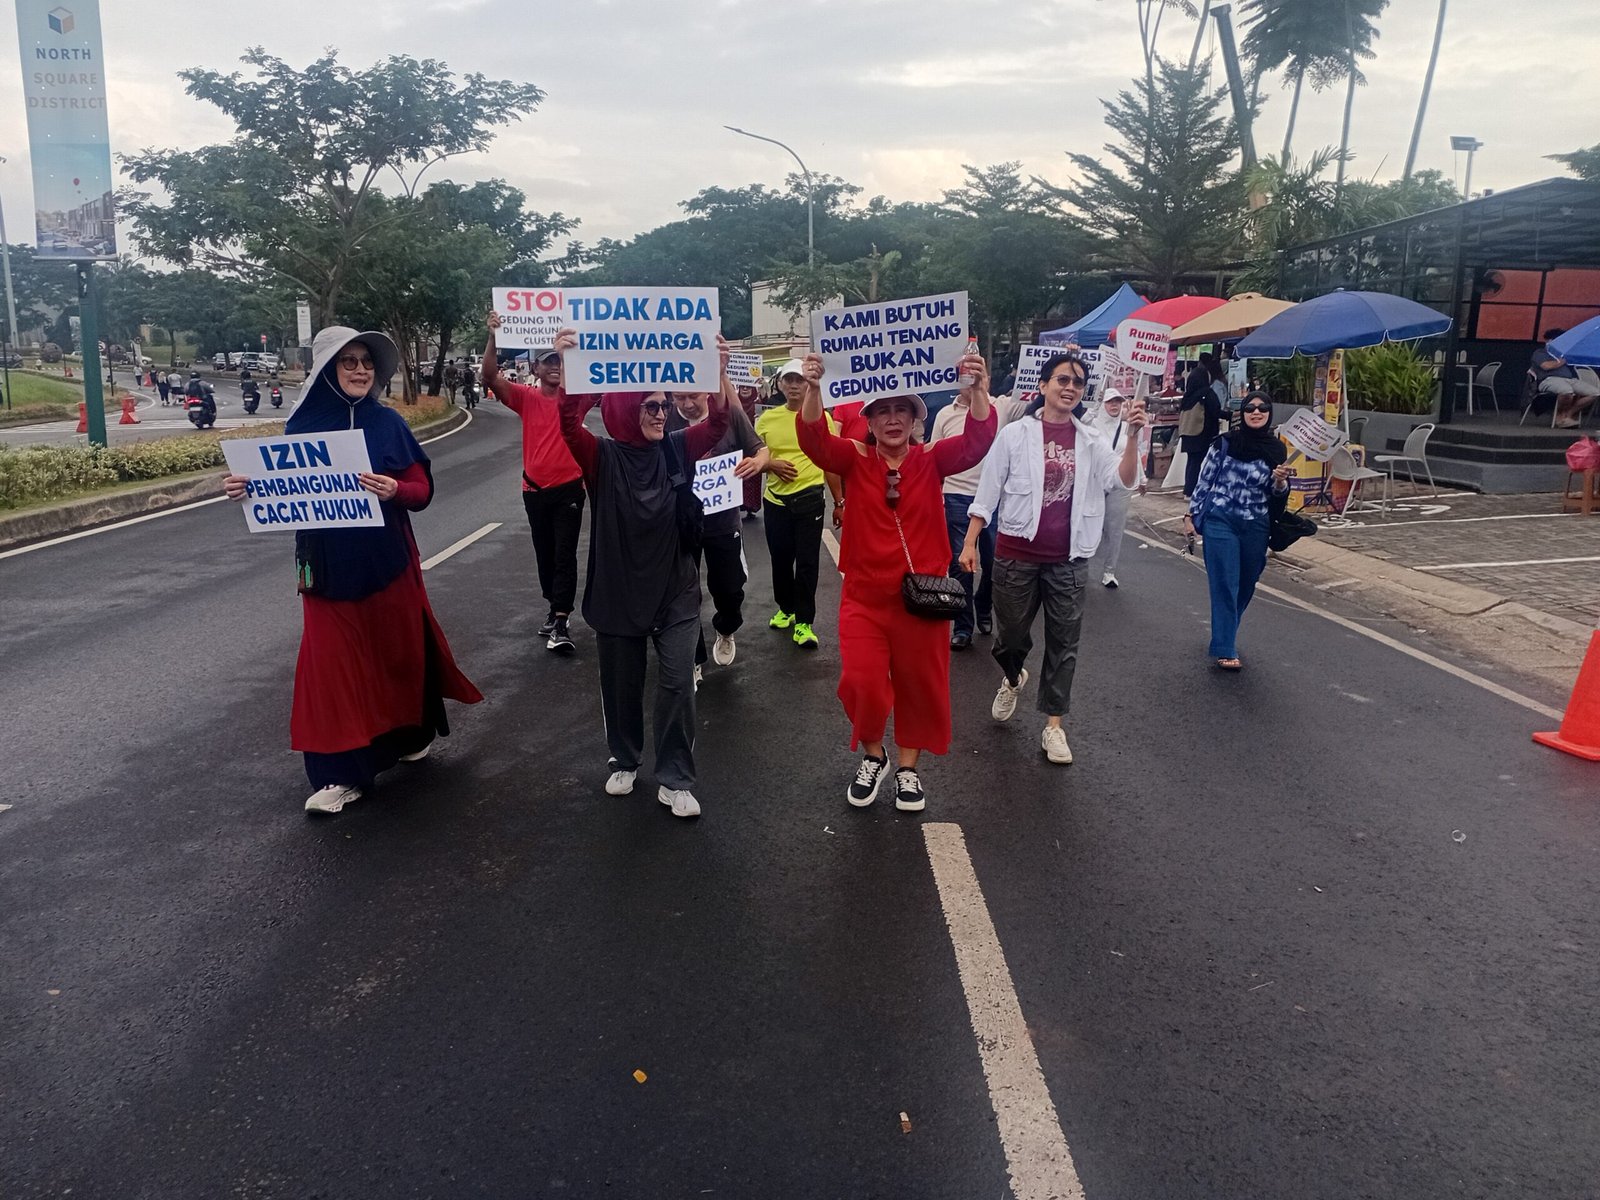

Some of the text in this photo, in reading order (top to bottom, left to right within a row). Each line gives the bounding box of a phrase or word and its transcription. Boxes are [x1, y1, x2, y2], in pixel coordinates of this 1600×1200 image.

[36, 48, 91, 60] NORTH
[33, 72, 97, 87] SQUARE
[28, 97, 105, 109] DISTRICT
[507, 291, 562, 311] STO
[568, 298, 712, 321] TIDAK ADA
[500, 315, 544, 324] GEDUNG
[824, 299, 955, 331] KAMI BUTUH
[503, 327, 562, 335] DI LINGKUN
[579, 333, 703, 350] IZIN WARGA
[820, 322, 961, 353] RUMAH TENANG
[850, 346, 934, 373] BUKAN
[589, 362, 695, 384] SEKITAR
[829, 366, 959, 398] GEDUNG TINGGI
[259, 441, 332, 471] IZIN
[696, 456, 737, 476] RKAN
[246, 473, 366, 498] PEMBANGUNAN
[253, 499, 373, 524] CACAT HUKUM
